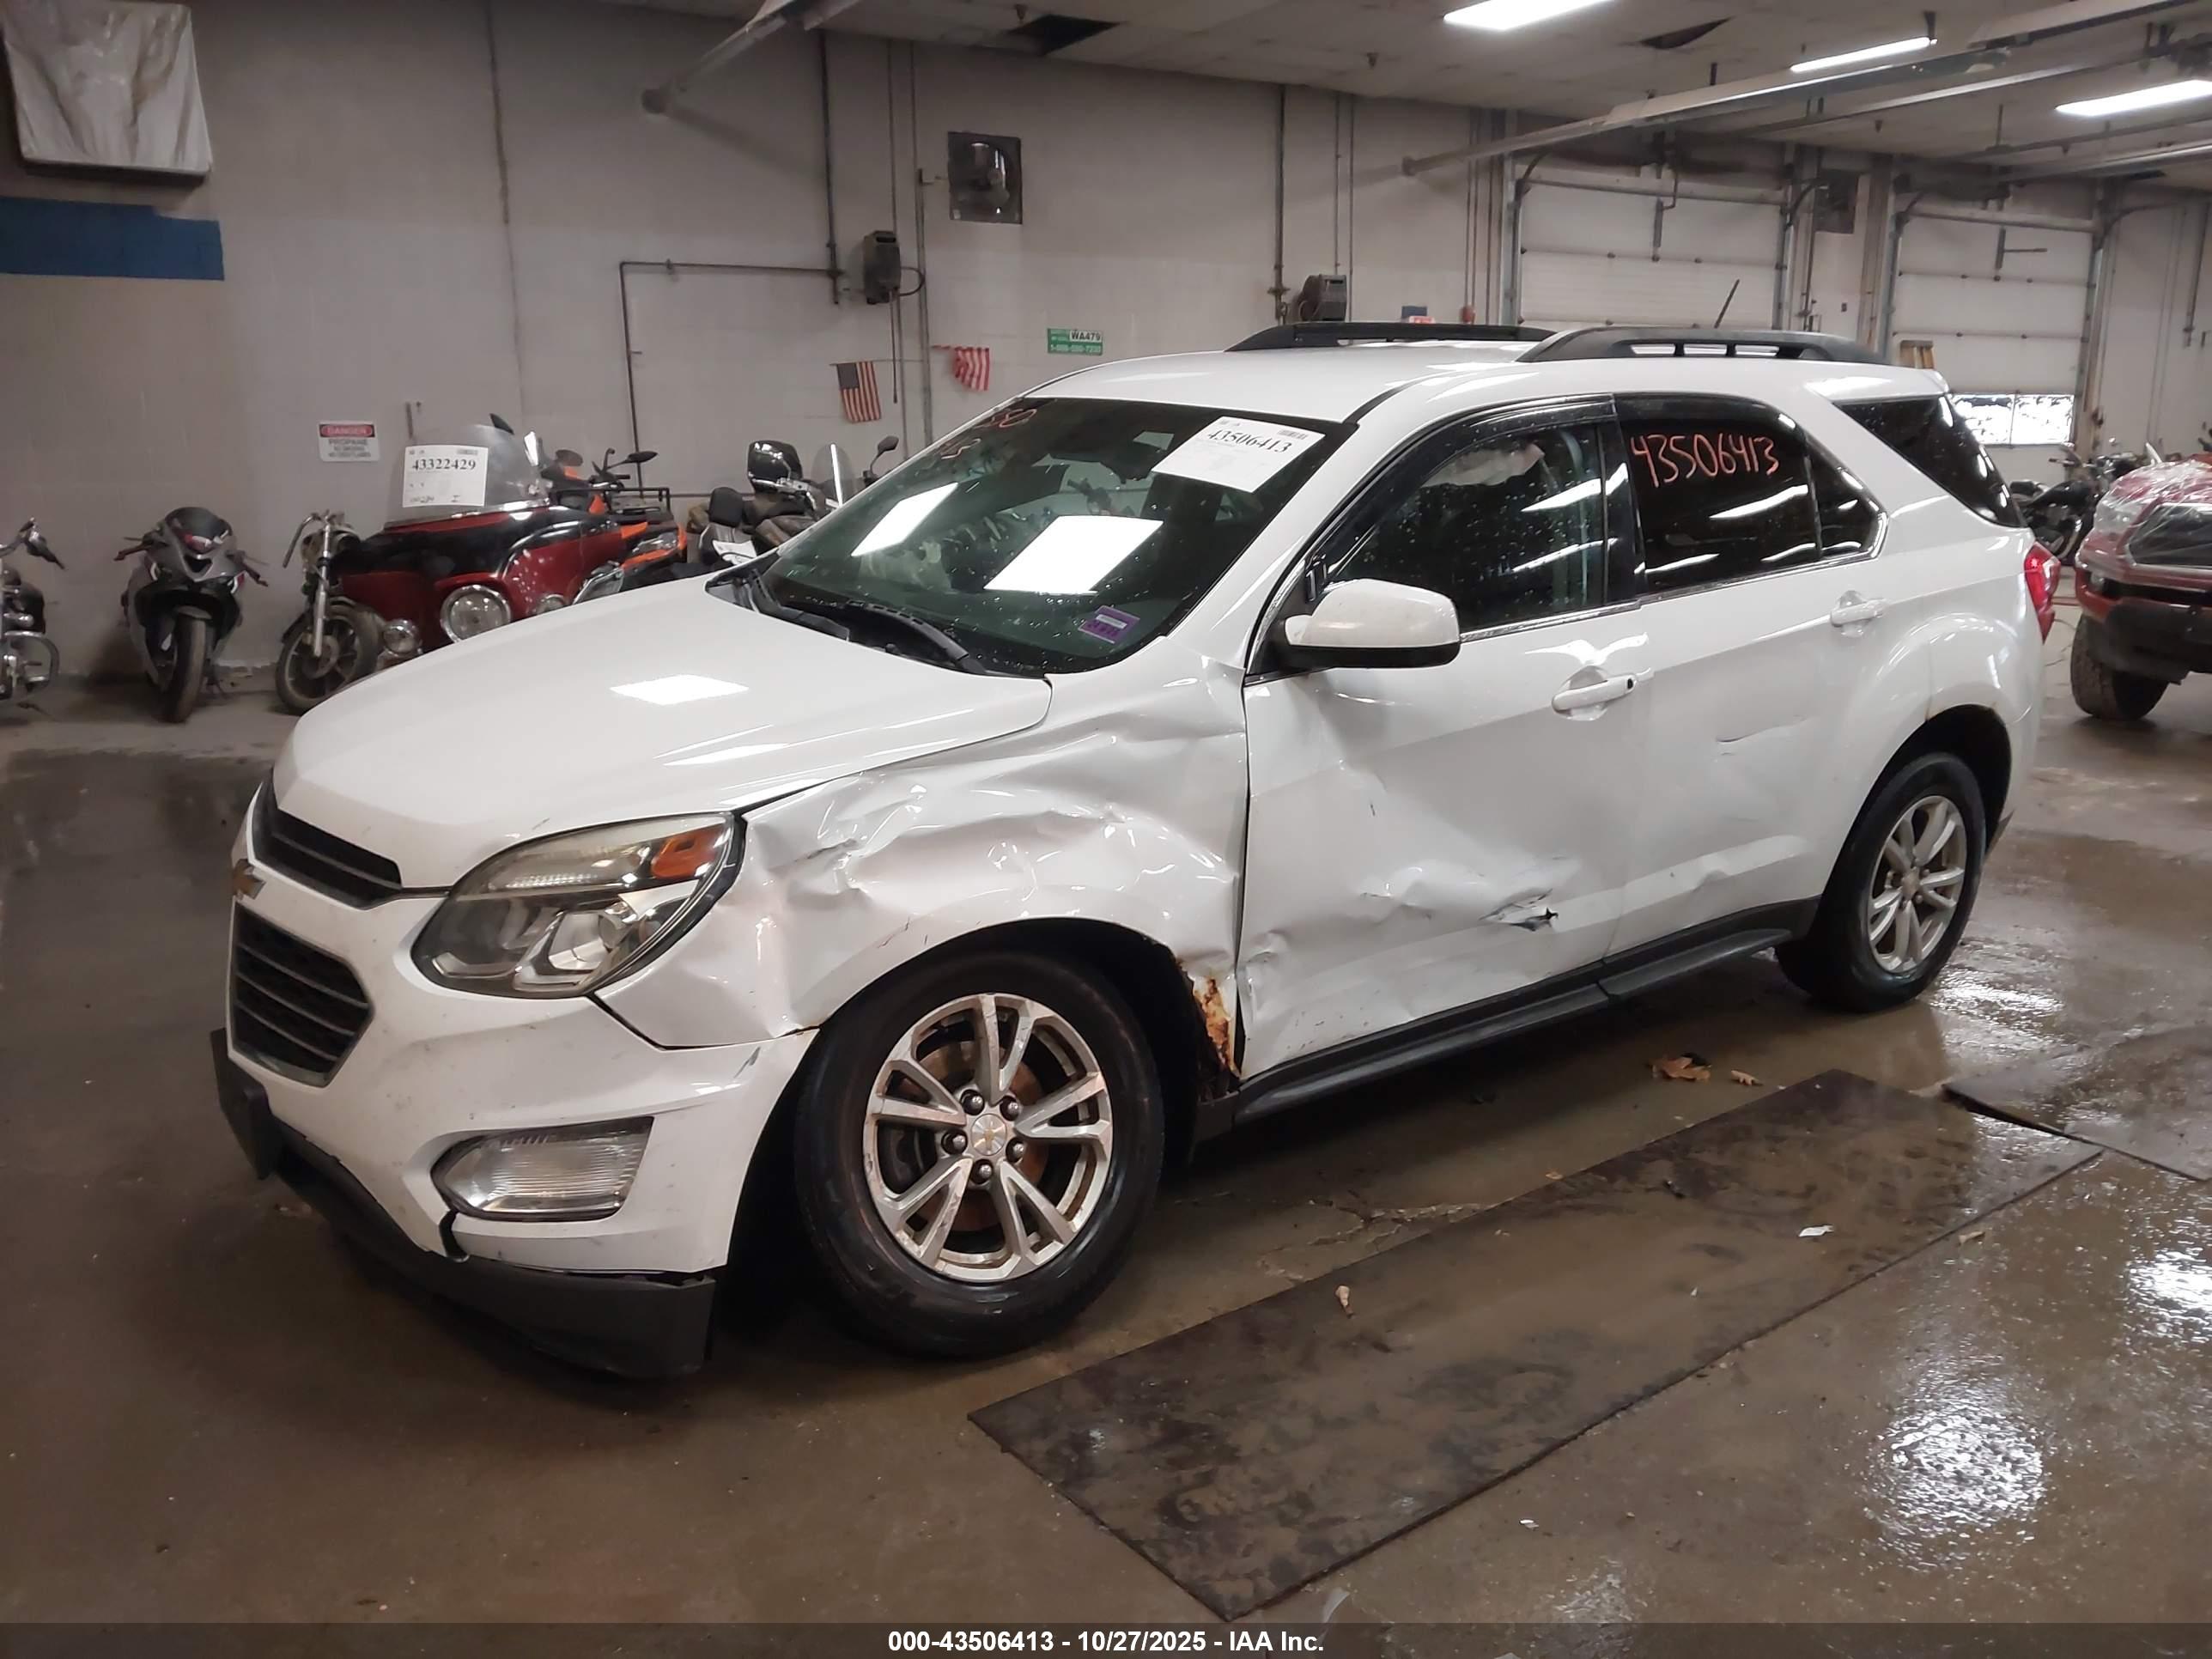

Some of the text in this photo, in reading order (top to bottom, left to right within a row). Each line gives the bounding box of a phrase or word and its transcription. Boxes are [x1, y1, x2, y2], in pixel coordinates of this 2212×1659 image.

[1071, 330, 1101, 341] WA479
[1207, 429, 1292, 453] 43506413
[412, 458, 477, 471] 43322429
[1631, 433, 1779, 488] 43506413
